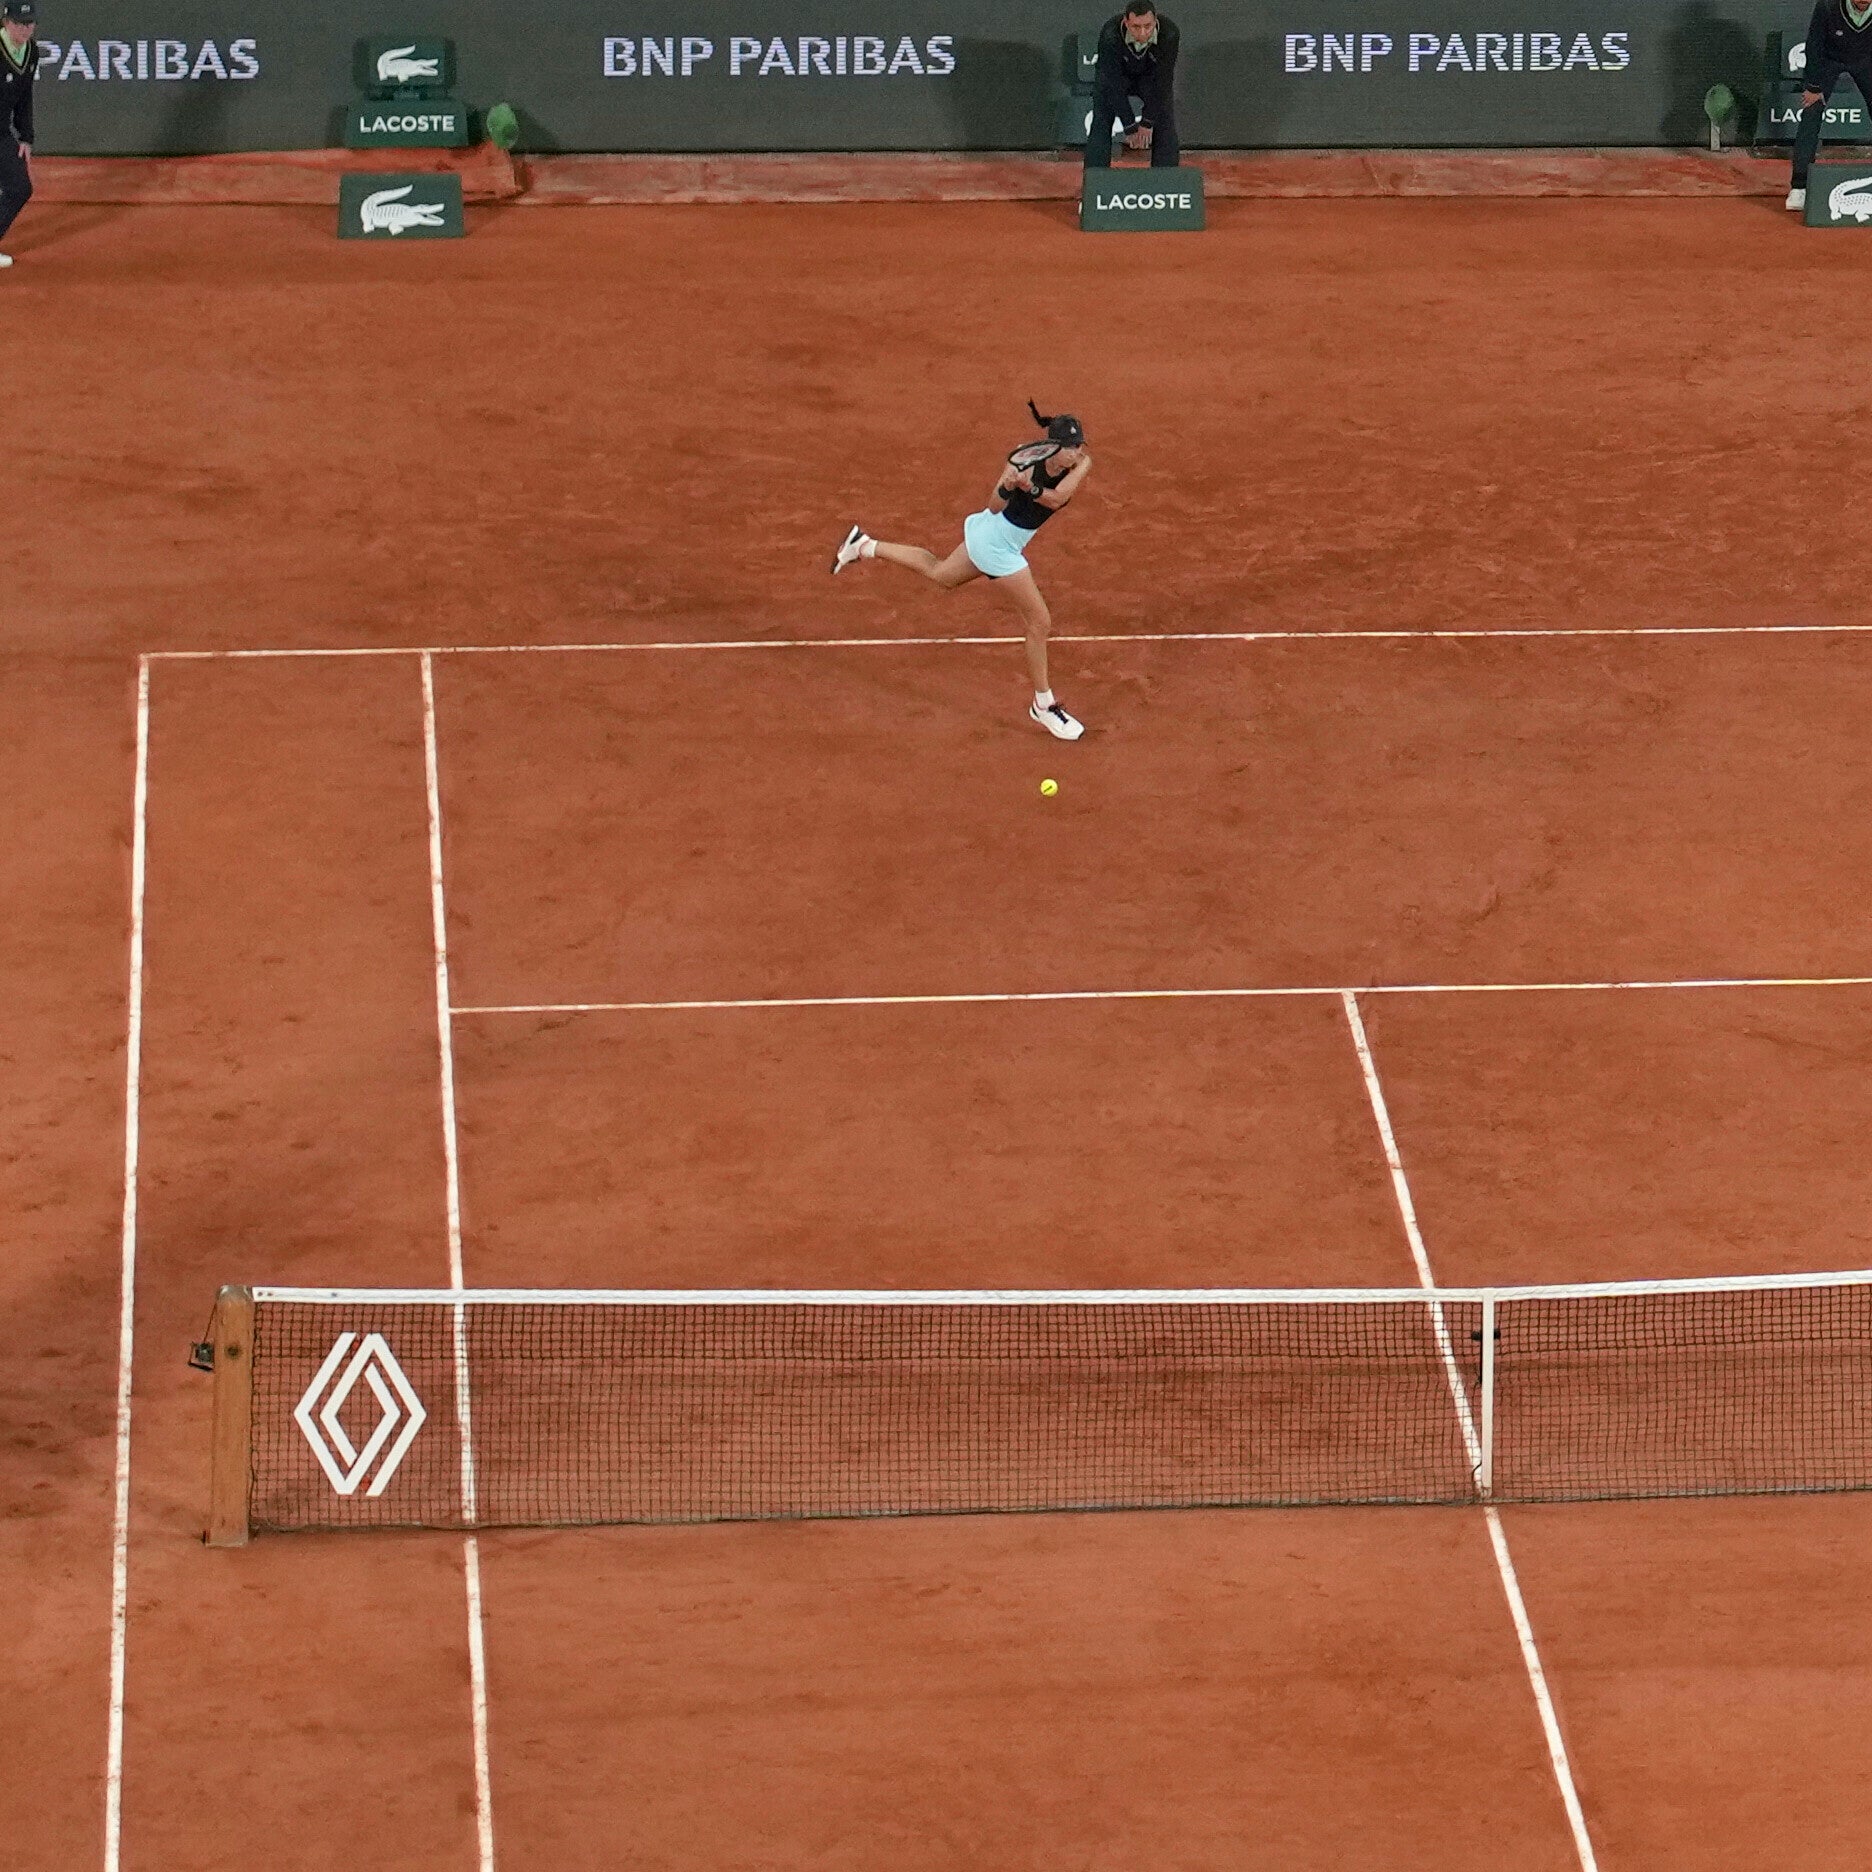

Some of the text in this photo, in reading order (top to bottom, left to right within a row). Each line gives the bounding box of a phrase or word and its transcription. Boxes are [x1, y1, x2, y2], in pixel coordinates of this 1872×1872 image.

[34, 38, 260, 81] PARIBAS
[603, 35, 956, 77] BNP PARIBAS
[1285, 32, 1629, 73] BNP PARIBAS
[360, 114, 455, 134] LACOSTE
[1770, 108, 1861, 124] LACSTE
[1096, 193, 1192, 211] LACOSTE
